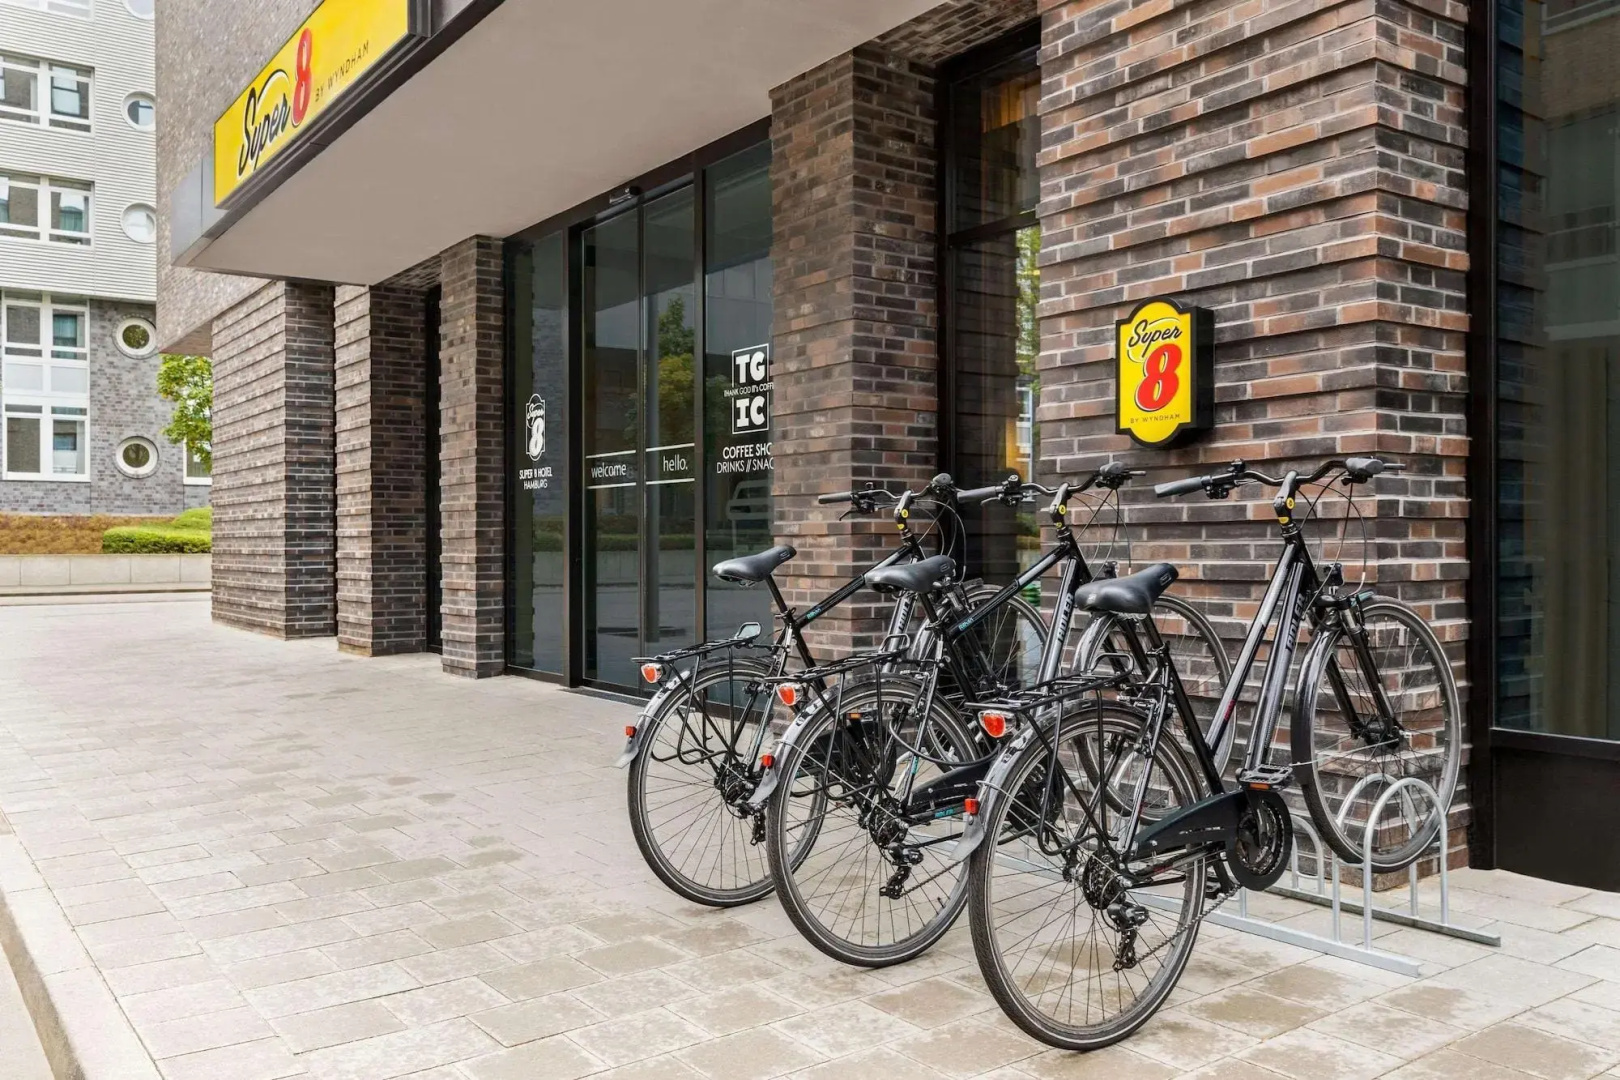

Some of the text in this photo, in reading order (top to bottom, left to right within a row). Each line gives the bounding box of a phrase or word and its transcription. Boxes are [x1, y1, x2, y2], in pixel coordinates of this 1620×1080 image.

[315, 39, 369, 102] BY WYNDHAM
[238, 28, 312, 177] Super 8
[1128, 318, 1183, 358] Super
[735, 351, 765, 384] TG
[1134, 343, 1183, 412] 8
[739, 386, 751, 395] GOD
[759, 382, 774, 392] COFF
[736, 395, 765, 428] IC
[1142, 414, 1181, 423] WYNDHAM
[529, 417, 544, 457] 8
[722, 441, 773, 459] COFFEE SHO
[591, 462, 627, 479] welcome
[662, 453, 688, 472] hello.
[716, 459, 745, 474] DRINKS
[752, 456, 774, 471] SNAC
[519, 468, 533, 480] SUPER
[537, 466, 553, 478] HOTEL
[523, 478, 548, 490] HAMBURG
